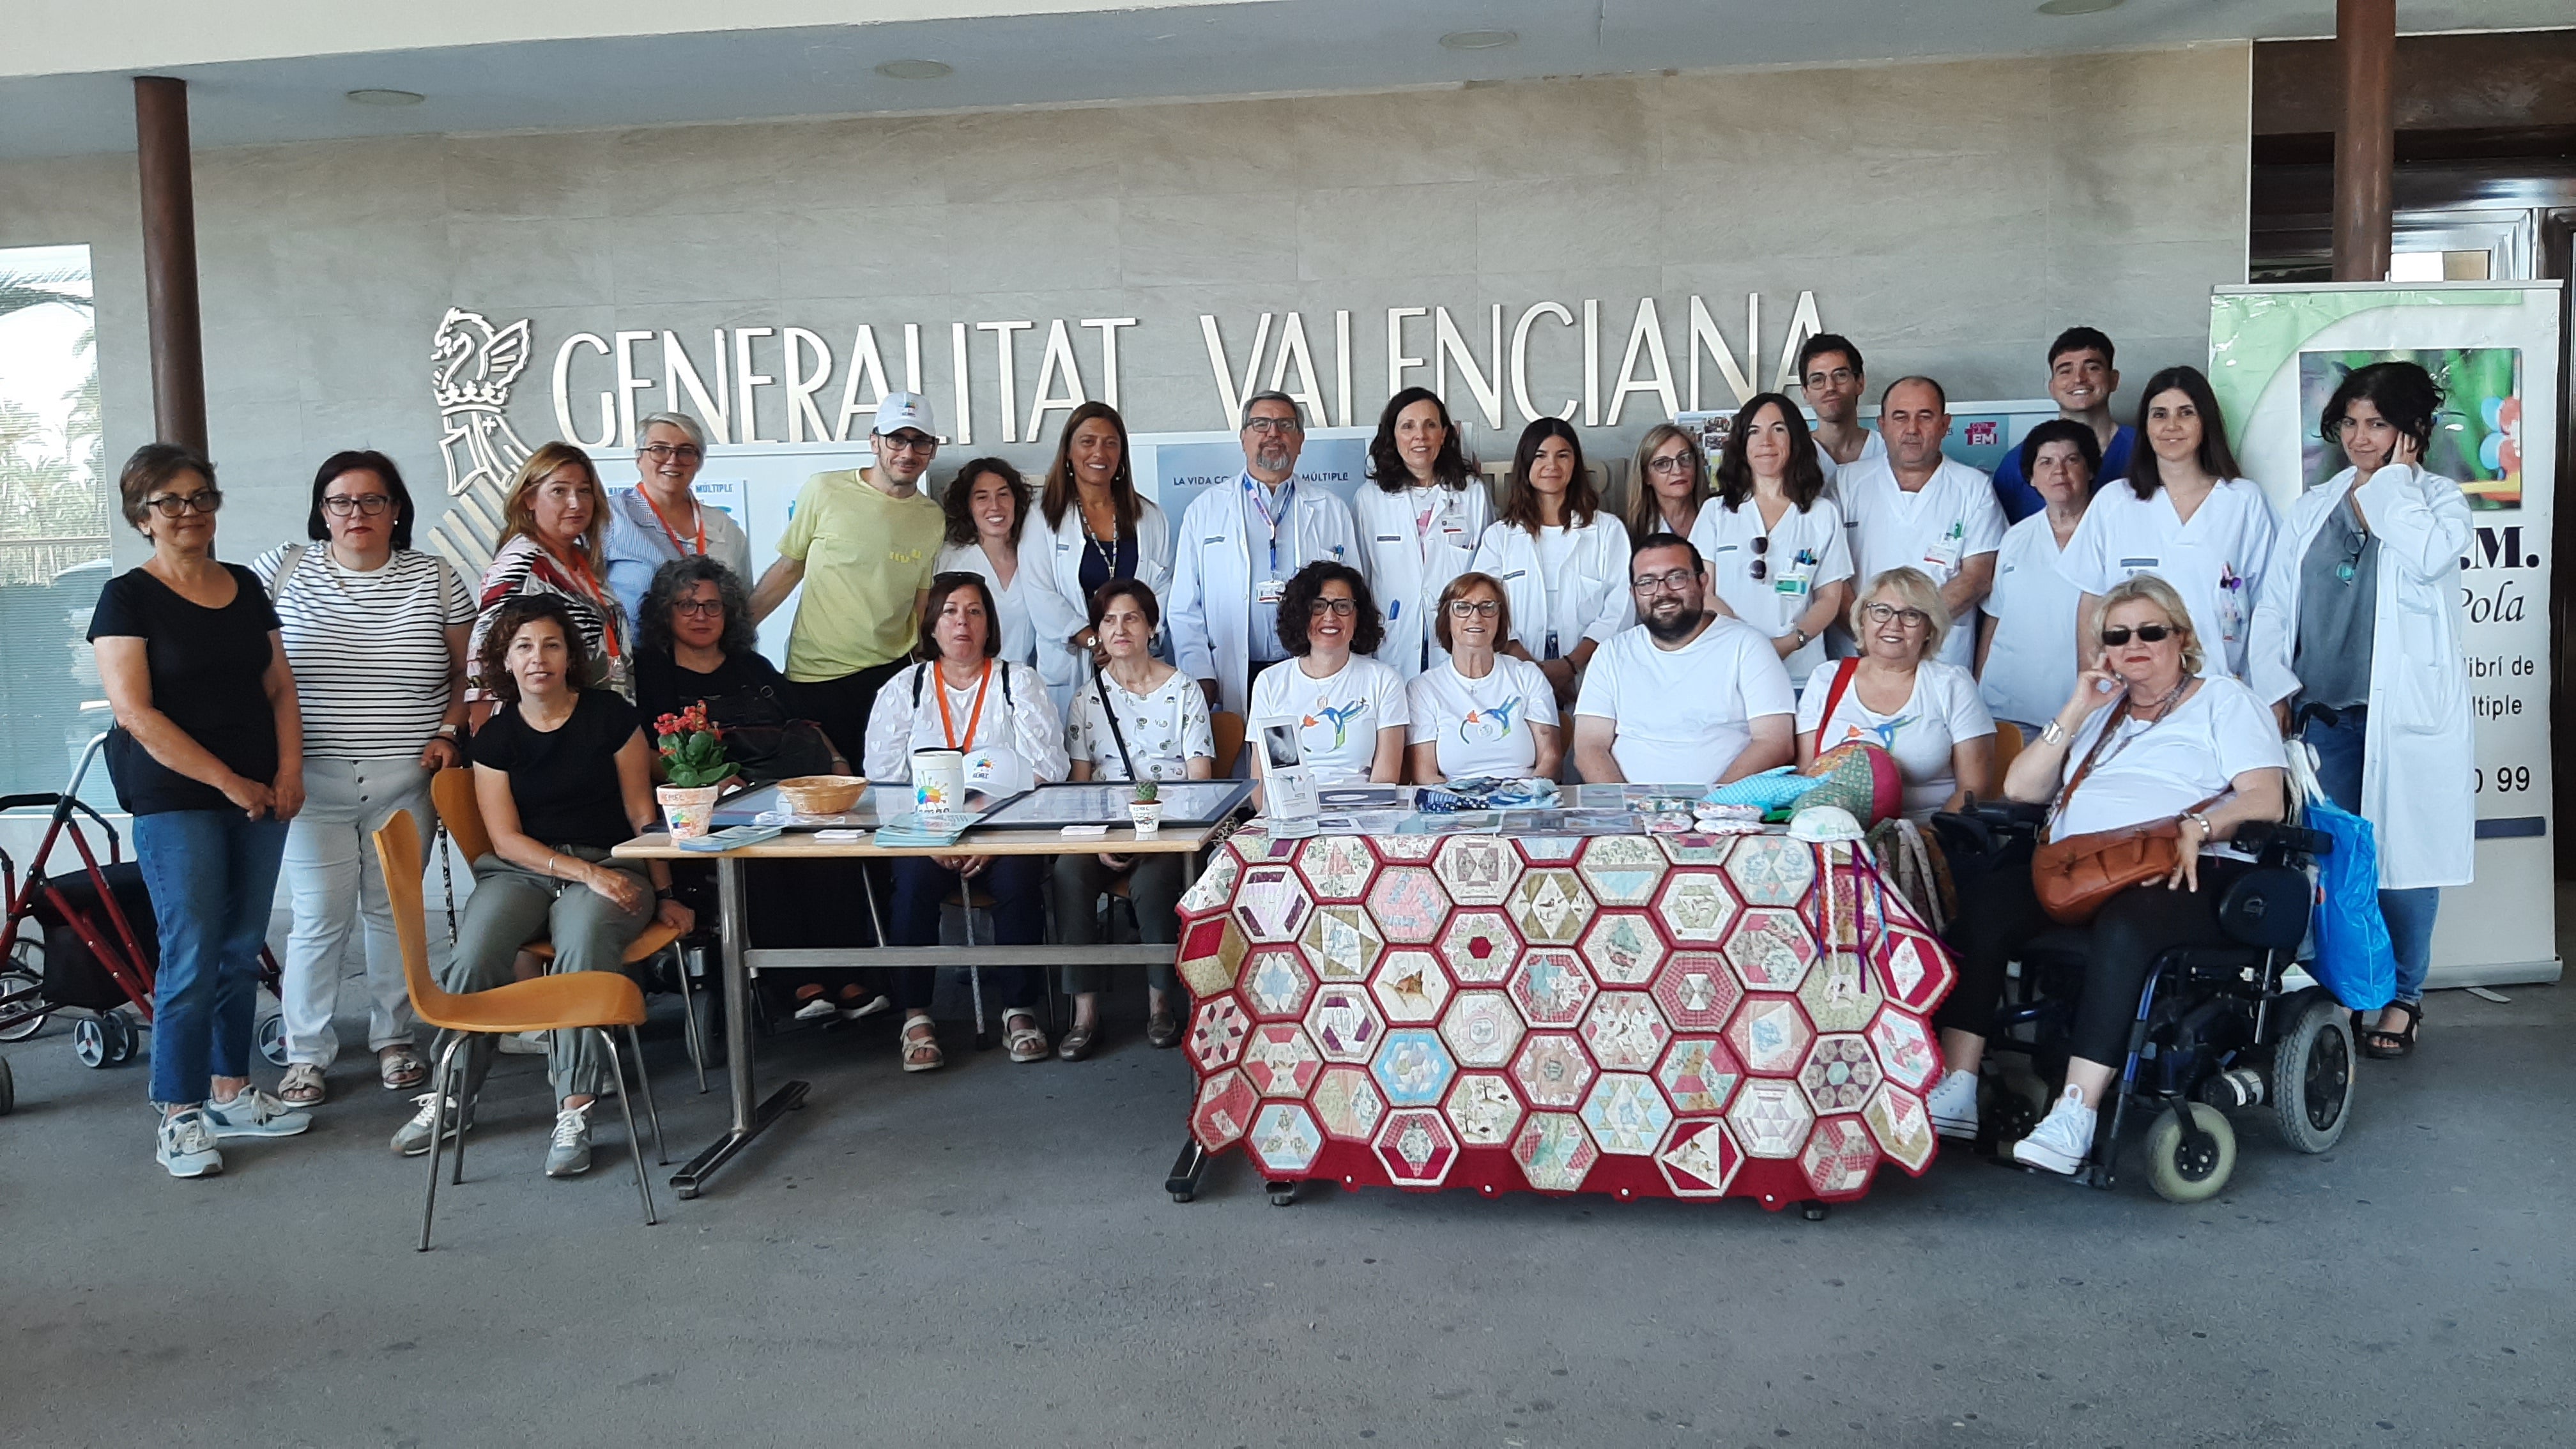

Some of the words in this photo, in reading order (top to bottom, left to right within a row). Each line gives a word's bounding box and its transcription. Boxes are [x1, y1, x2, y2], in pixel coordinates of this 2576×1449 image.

[552, 317, 1137, 448] GENERALITAT
[1199, 290, 1823, 431] VALENCIANA
[1174, 477, 1185, 486] LA
[1187, 476, 1212, 485] VIDA
[1301, 471, 1349, 482] MÚLTIPLE
[2464, 655, 2503, 678] ibrí
[2511, 655, 2534, 676] de
[2497, 766, 2531, 793] 99
